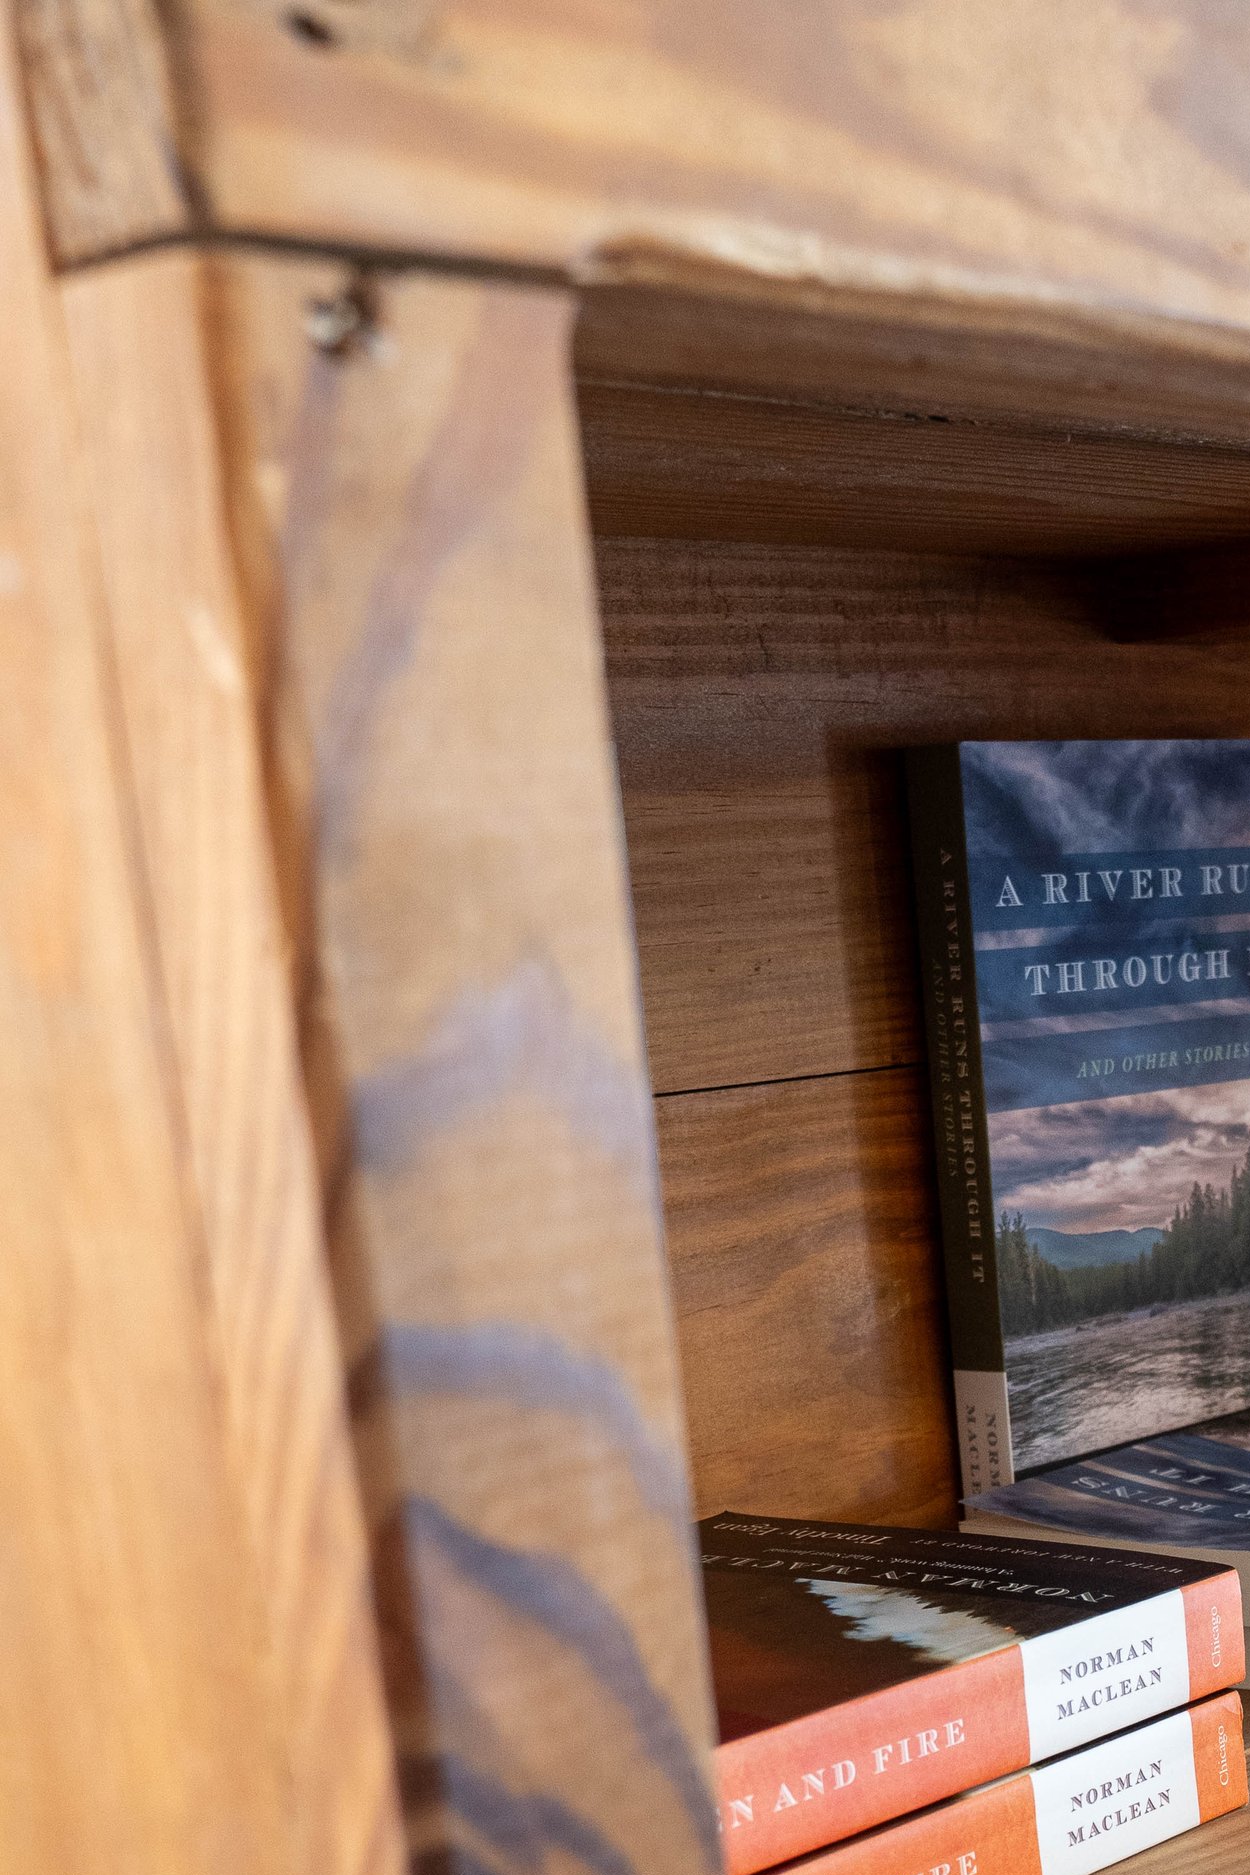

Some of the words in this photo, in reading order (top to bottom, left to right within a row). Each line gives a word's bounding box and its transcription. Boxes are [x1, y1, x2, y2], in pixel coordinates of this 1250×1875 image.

[940, 848, 952, 866] A
[996, 876, 1023, 907] A
[1041, 867, 1183, 905] RIVER
[941, 880, 963, 982] RIVER
[932, 958, 946, 1008] AND
[1024, 950, 1230, 997] THROUGH
[935, 1012, 952, 1083] OTHER
[951, 997, 970, 1079] RUNS
[1077, 1058, 1116, 1079] AND
[1122, 1050, 1179, 1072] OTHER
[1184, 1041, 1250, 1066] STORIES
[941, 1093, 959, 1179] STORIES
[958, 1089, 981, 1238] THROUGH
[970, 1253, 986, 1285] IT
[1070, 1475, 1218, 1514] RUNS
[1148, 1466, 1216, 1485] IT
[711, 1523, 780, 1537] Egan
[781, 1527, 894, 1547] Timothy
[938, 1541, 1050, 1558] FOREWORD
[870, 1569, 1115, 1604] NORMAN
[1058, 1636, 1157, 1686] NORMAN
[1210, 1605, 1223, 1669] Chicago
[1056, 1667, 1164, 1721] MACLEAN
[771, 1758, 857, 1814] AND
[872, 1717, 967, 1777] FIRE
[1219, 1724, 1231, 1786] Chicago
[1069, 1758, 1164, 1813] NORMAN
[1067, 1788, 1172, 1848] MACLEAN
